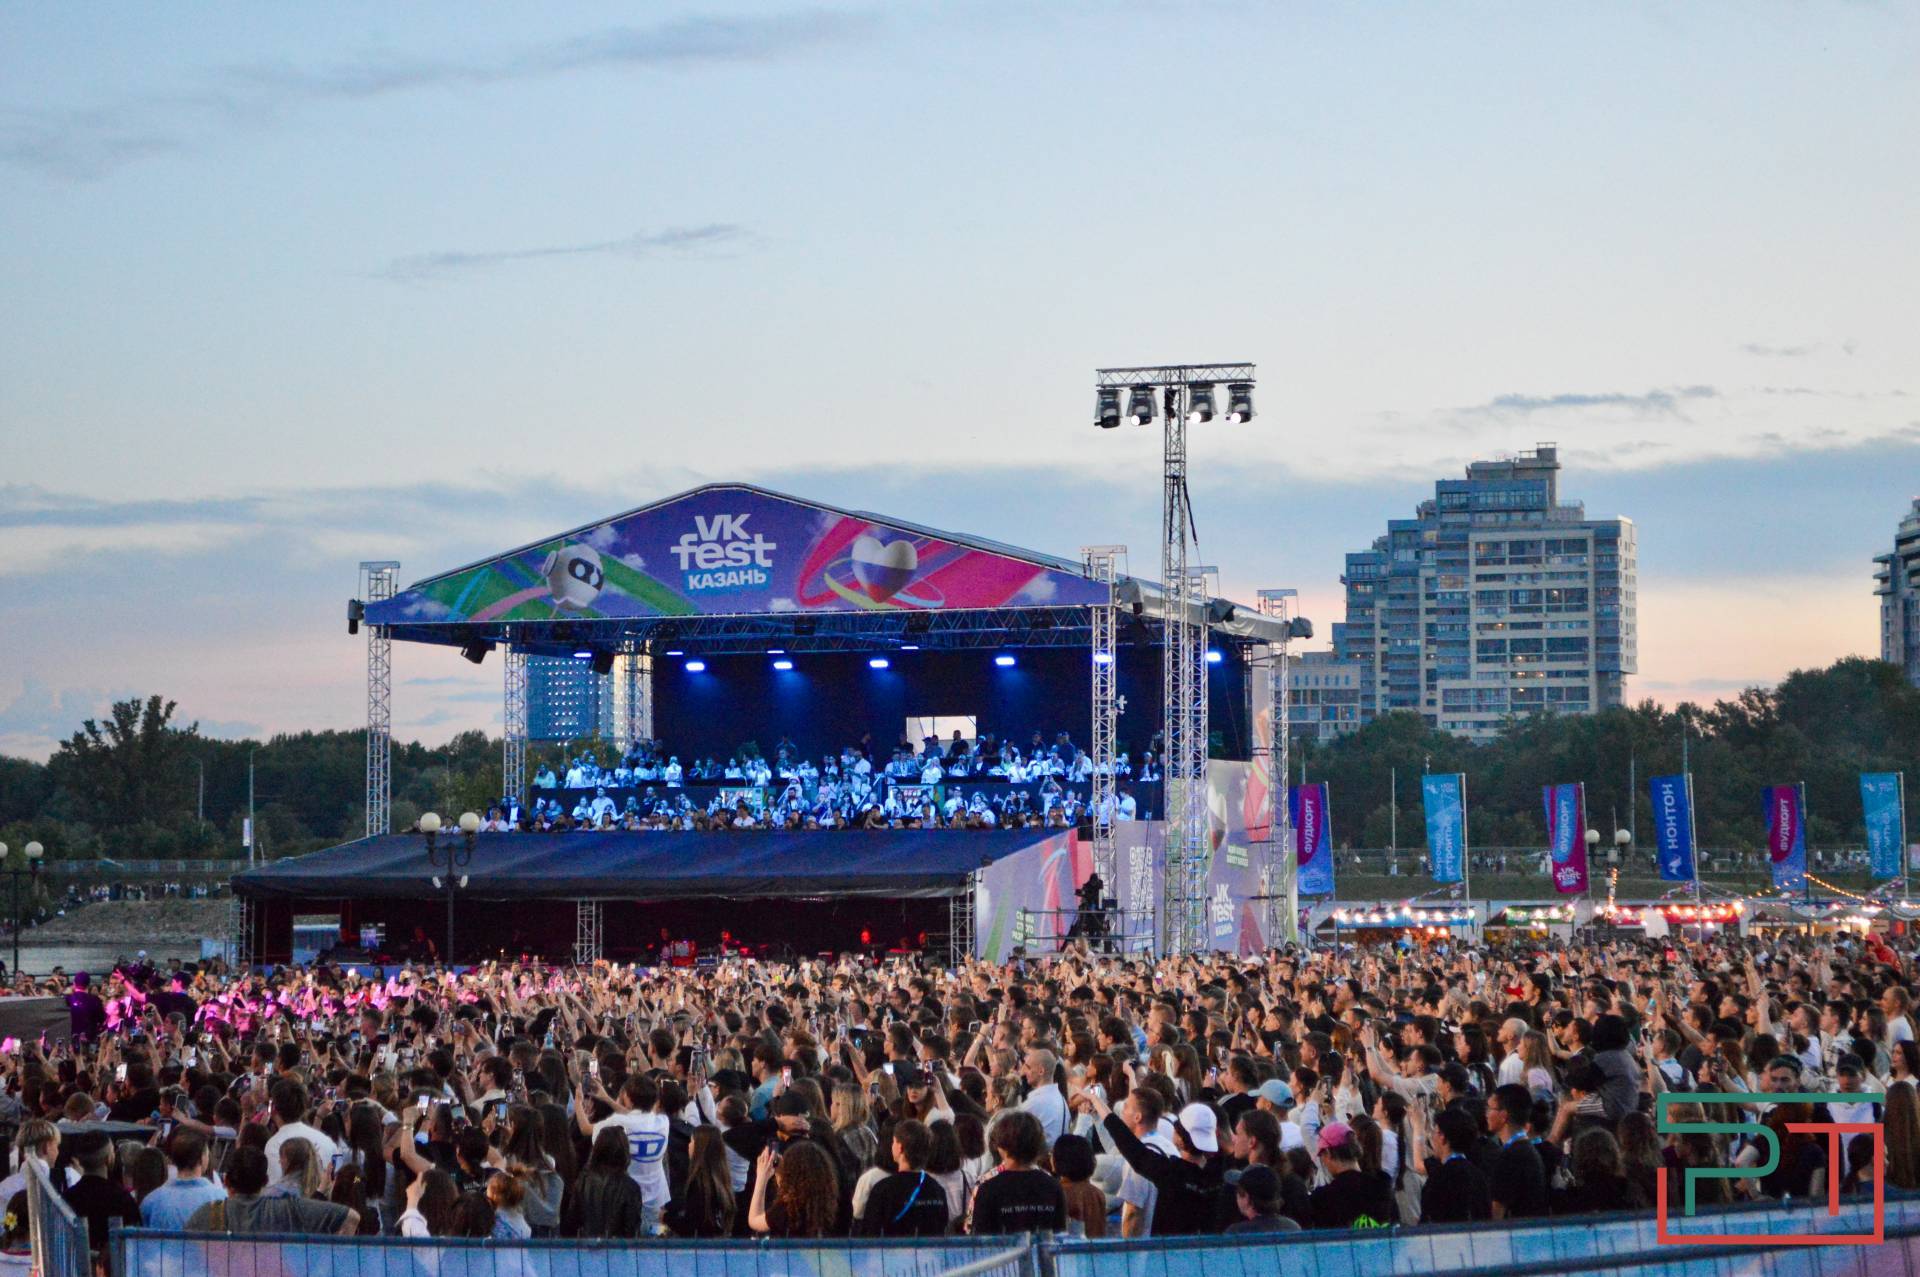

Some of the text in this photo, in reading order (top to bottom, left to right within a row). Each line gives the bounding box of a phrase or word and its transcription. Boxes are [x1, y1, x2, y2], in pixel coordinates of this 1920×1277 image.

[670, 533, 777, 570] fest
[694, 513, 752, 540] VK
[688, 569, 767, 590] КАЗАНЬ
[1304, 798, 1314, 853] ФУДКОРТ
[1561, 799, 1570, 853] ФУДКОРТ
[1662, 784, 1679, 849] НОНТОН
[1780, 798, 1790, 851] ФУДКОРТ
